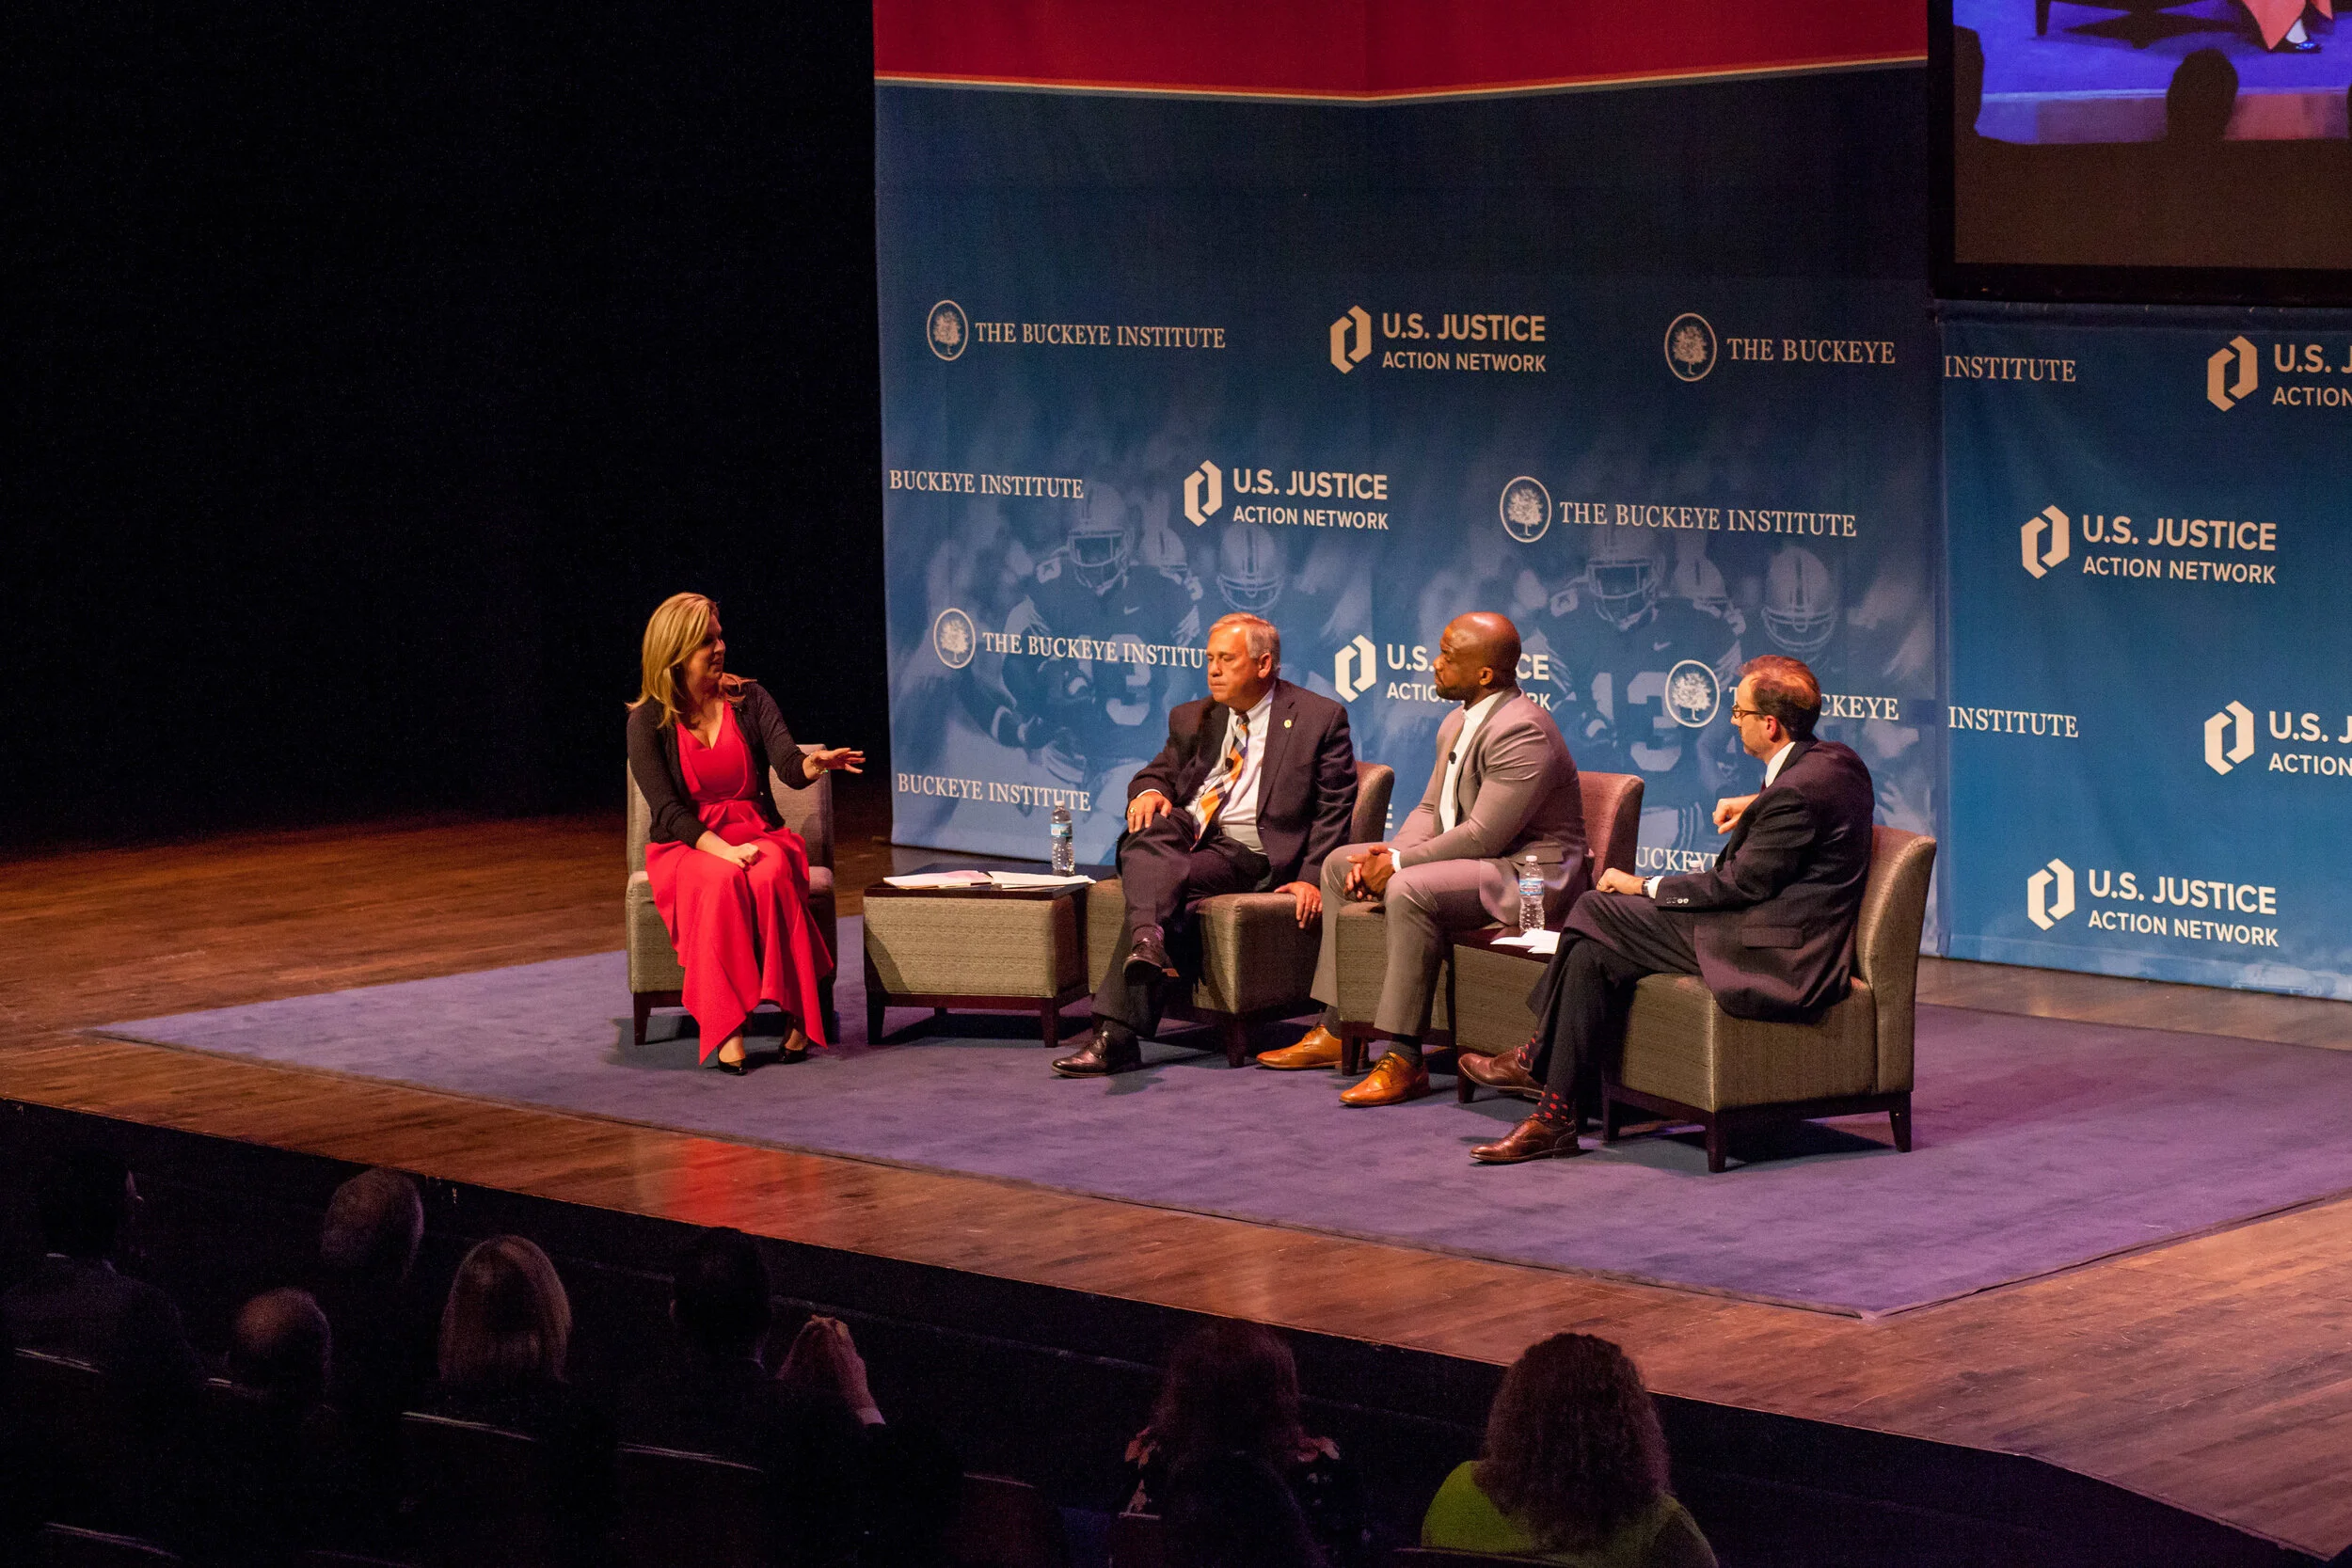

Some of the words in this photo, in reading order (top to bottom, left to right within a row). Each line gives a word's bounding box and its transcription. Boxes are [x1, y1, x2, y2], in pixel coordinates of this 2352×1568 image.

[975, 322, 1017, 343] THE
[1022, 323, 1111, 345] BUCKEYE
[1117, 325, 1226, 349] INSTITUTE
[1382, 312, 1430, 340] U.S.
[1437, 313, 1546, 341] JUSTICE
[1382, 351, 1450, 370] ACTION
[1455, 353, 1547, 372] NETWORK
[1726, 338, 1774, 361] THE
[1782, 339, 1896, 364] BUCKEYE
[2274, 343, 2332, 373] U.S.
[1945, 356, 2076, 382] INSTITUTE
[889, 469, 976, 494] BUCKEYE
[980, 474, 1085, 499] INSTITUTE
[1233, 467, 1280, 495] U.S.
[1285, 470, 1388, 500] JUSTICE
[1232, 505, 1298, 525] ACTION
[1303, 509, 1389, 531] NETWORK
[1559, 501, 1608, 525] THE
[1615, 503, 1721, 531] BUCKEYE
[1727, 509, 1857, 537] INSTITUTE
[2082, 515, 2139, 545] U.S.
[2147, 517, 2277, 551] JUSTICE
[2082, 555, 2162, 578] ACTION
[2169, 560, 2276, 584] NETWORK
[981, 631, 1023, 655] THE
[1027, 635, 1119, 662] BUCKEYE
[1121, 641, 1208, 670] INSTITU
[1387, 643, 1436, 673] U.S.
[1386, 681, 1448, 704] ACTIO
[1820, 693, 1899, 721] CKEYE
[1947, 705, 2079, 738] INSTITUTE
[2268, 710, 2329, 743] U.S.
[2268, 752, 2352, 777] ACTION
[898, 773, 983, 800] BUCKEYE
[988, 782, 1091, 812] INSTITUTE
[2089, 868, 2145, 901] U.S.
[2152, 876, 2278, 916] JUSTICE
[2088, 910, 2168, 936] ACTION
[2173, 919, 2280, 947] NETWORK
